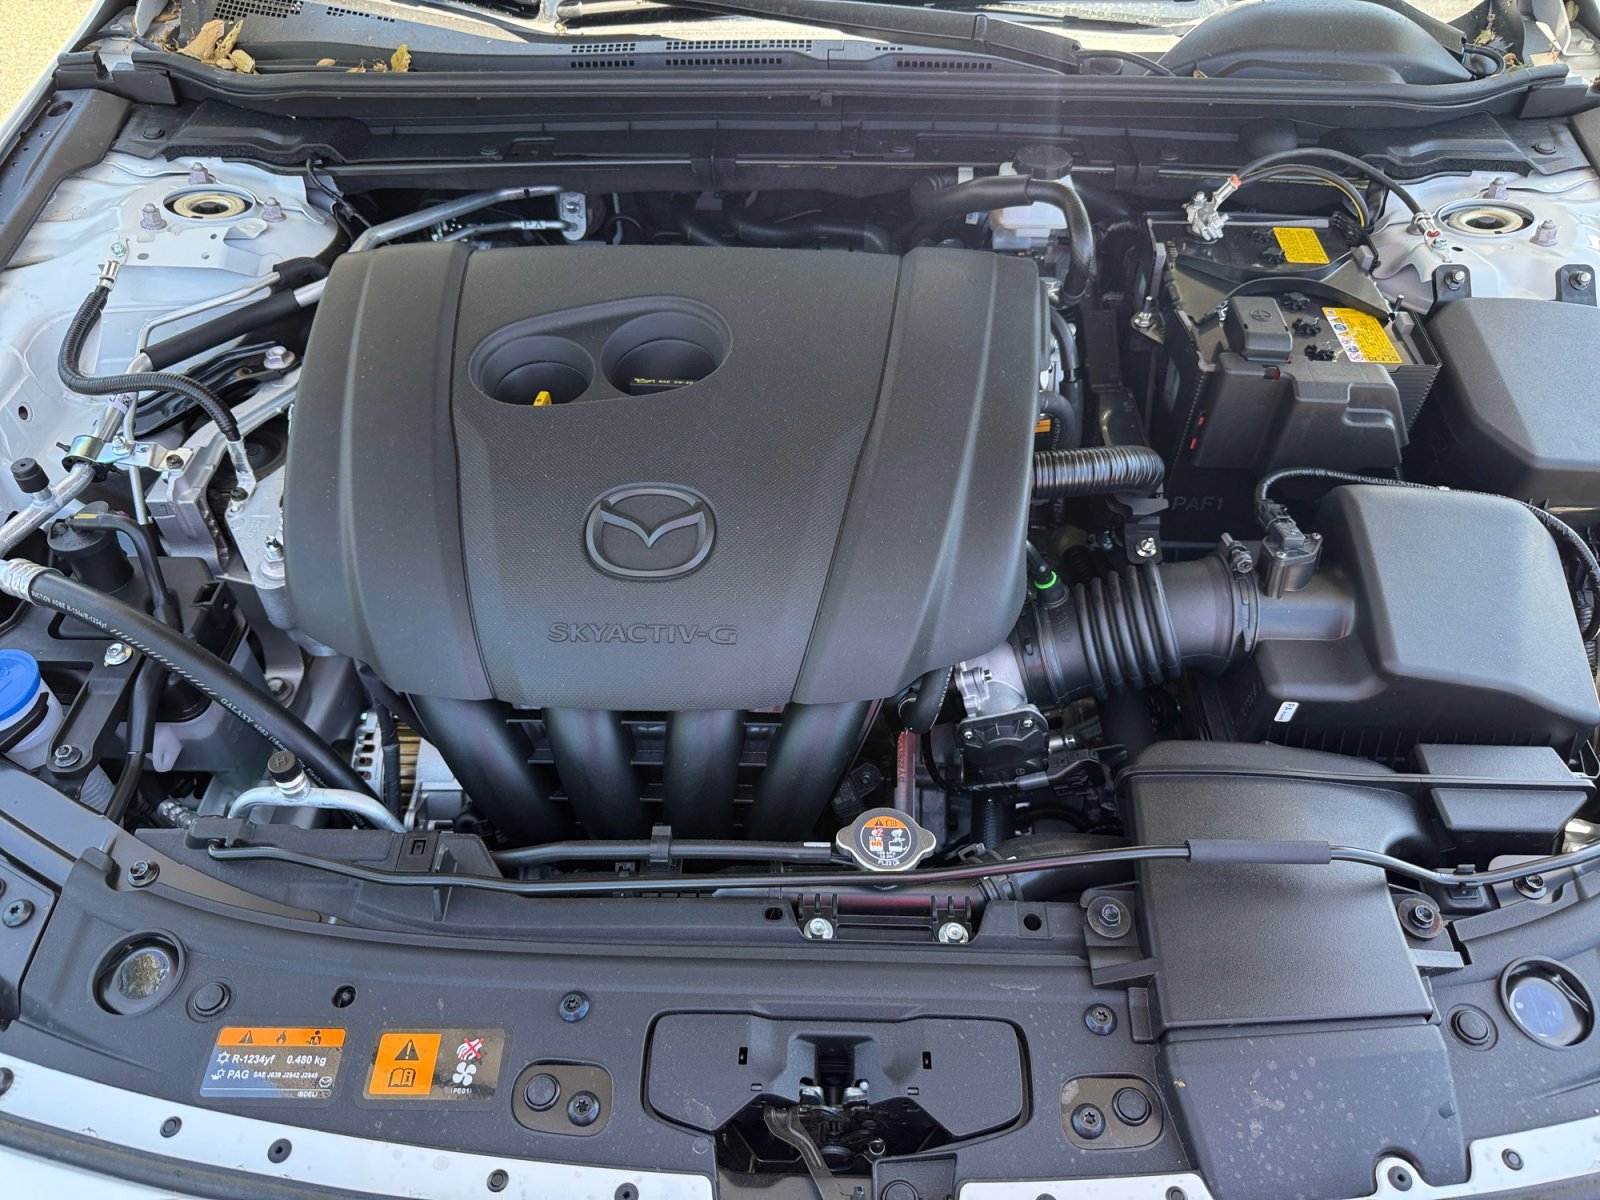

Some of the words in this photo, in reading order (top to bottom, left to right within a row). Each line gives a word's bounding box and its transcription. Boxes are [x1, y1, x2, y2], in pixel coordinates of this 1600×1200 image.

[1171, 495, 1224, 512] PAF1
[547, 622, 738, 646] SKYACTIV-G
[220, 698, 254, 724] GALAXY
[231, 1053, 275, 1066] R-1234yf
[286, 1054, 313, 1065] 0.480
[314, 1055, 327, 1066] kg
[227, 1069, 249, 1080] PAG
[253, 1071, 266, 1079] SAE
[267, 1071, 281, 1079] J639
